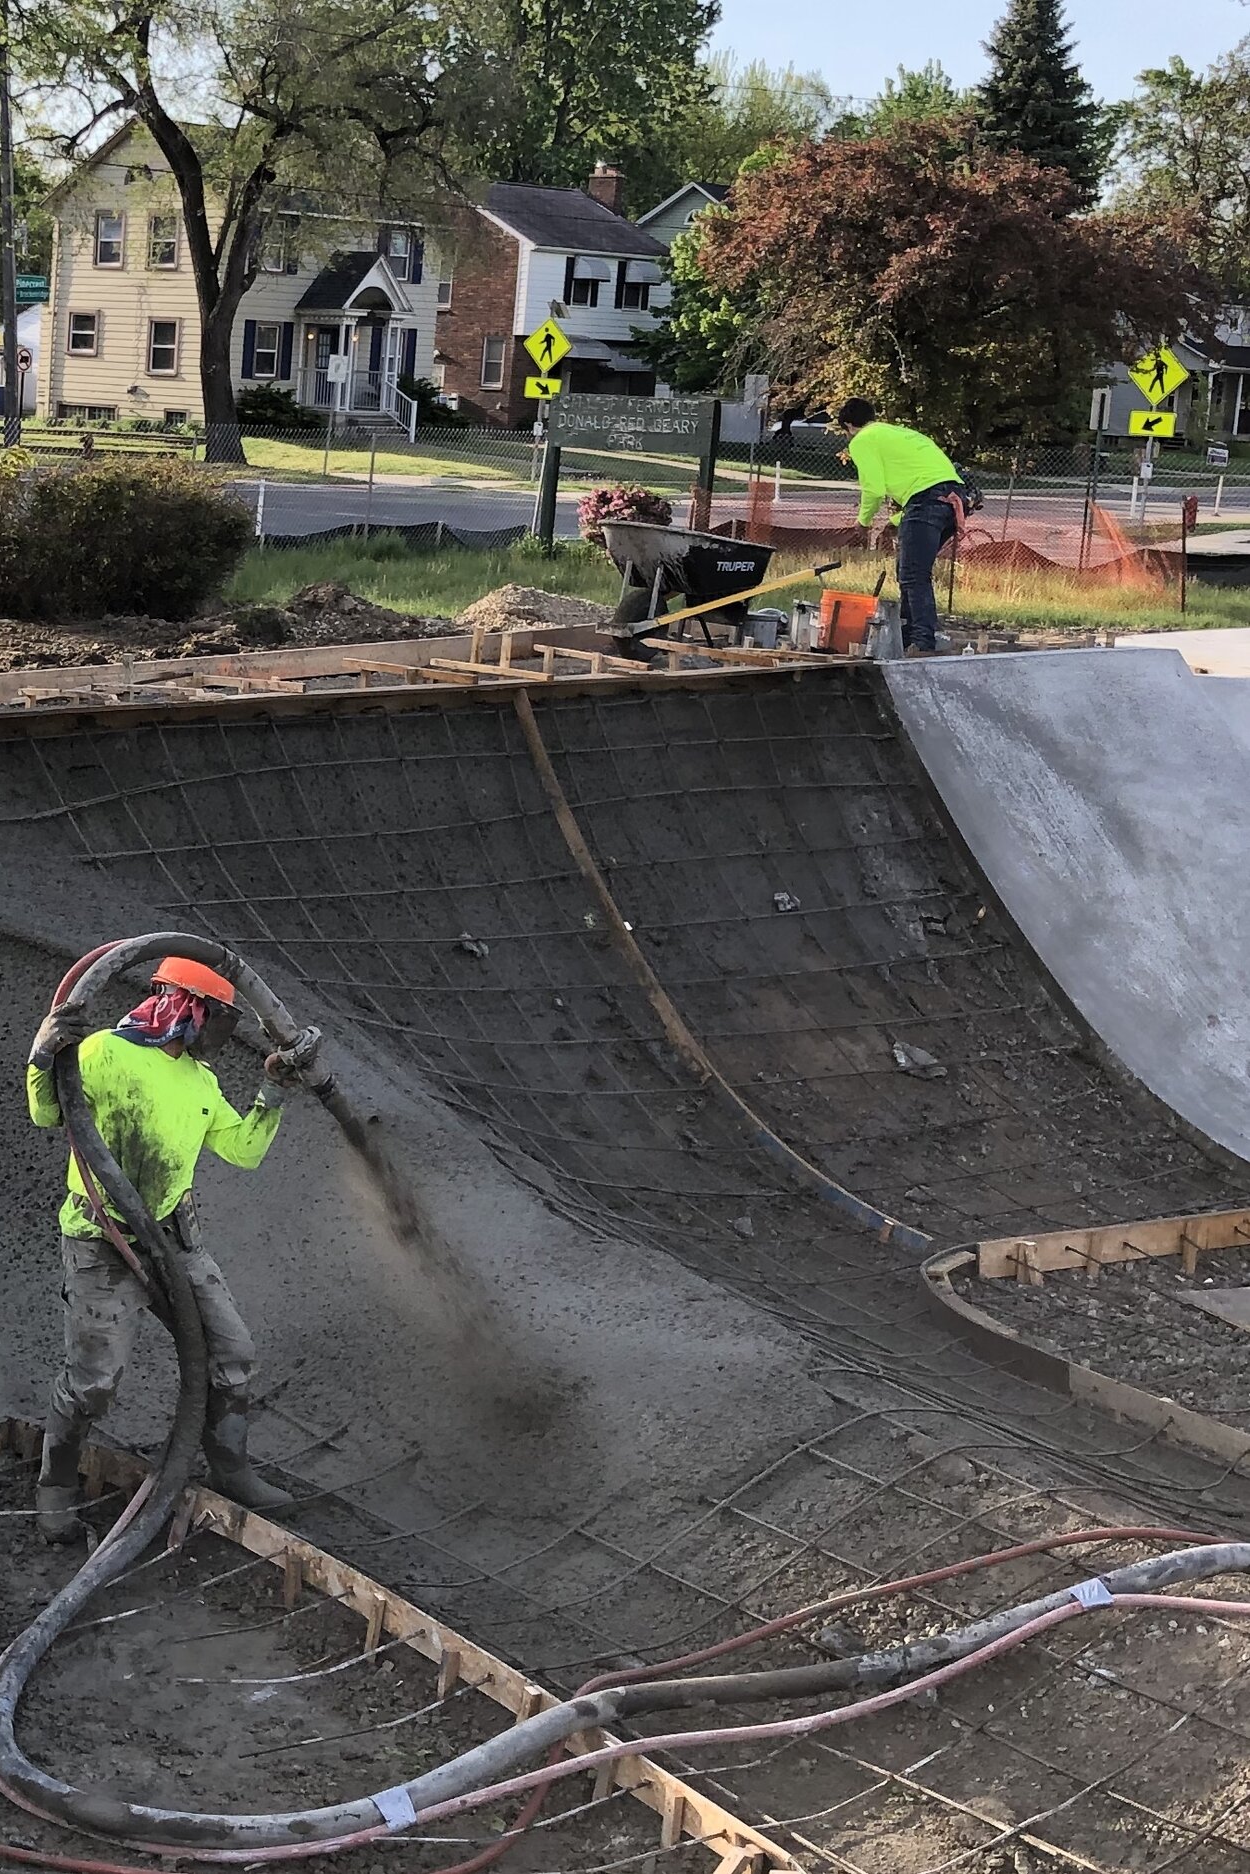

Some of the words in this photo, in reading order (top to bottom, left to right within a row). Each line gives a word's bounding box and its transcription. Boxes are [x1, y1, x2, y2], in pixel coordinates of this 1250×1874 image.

[627, 398, 700, 417] FERNDALE
[653, 418, 700, 434] GEARY
[607, 433, 644, 450] PARK
[716, 561, 755, 572] TRUPER
